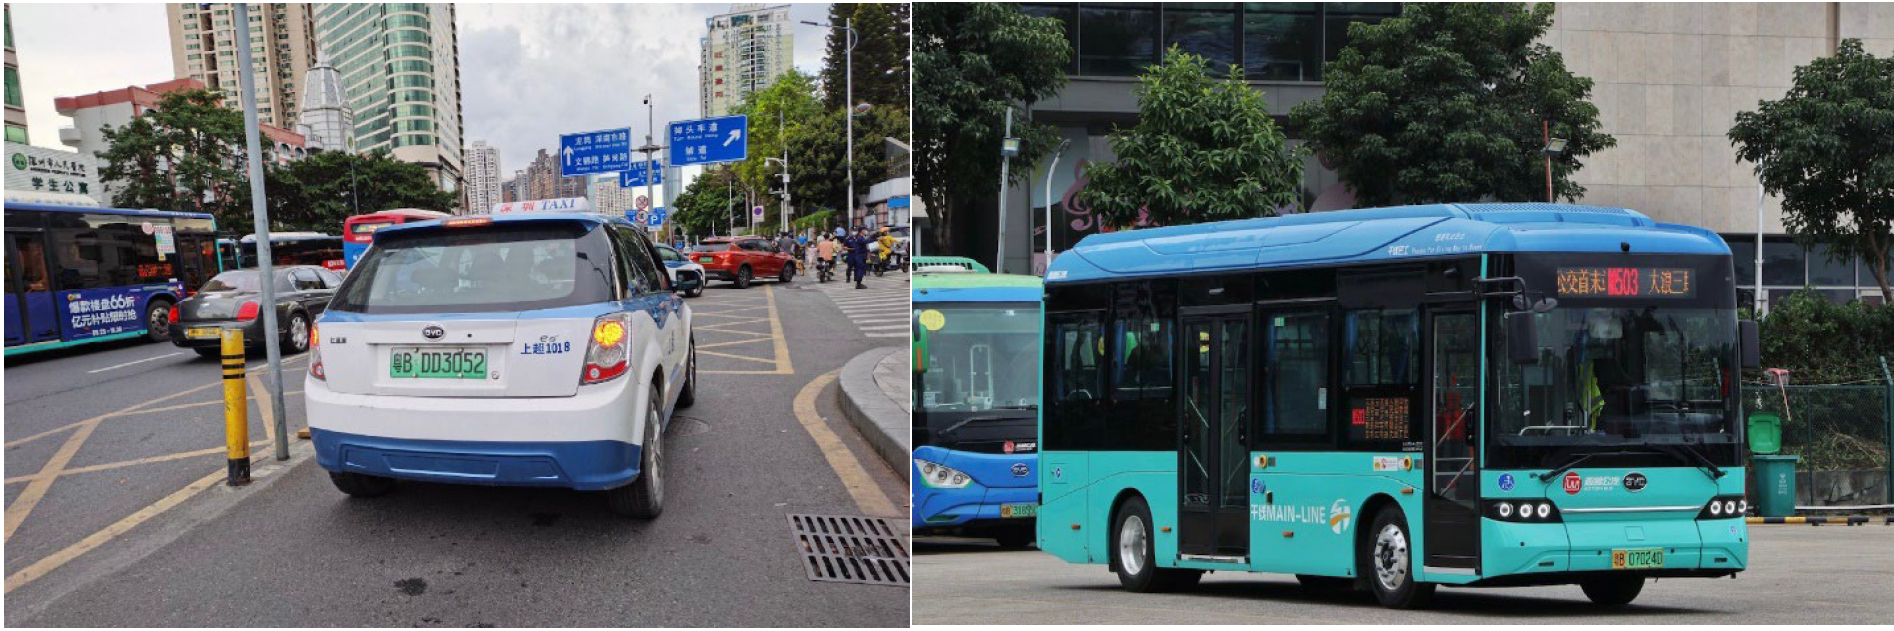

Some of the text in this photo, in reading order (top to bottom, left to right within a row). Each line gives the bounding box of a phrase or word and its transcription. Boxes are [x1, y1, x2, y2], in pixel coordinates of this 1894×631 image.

[32, 176, 88, 194] 学生公寓
[541, 198, 575, 211] TAXI
[1625, 476, 1645, 486] BYD
